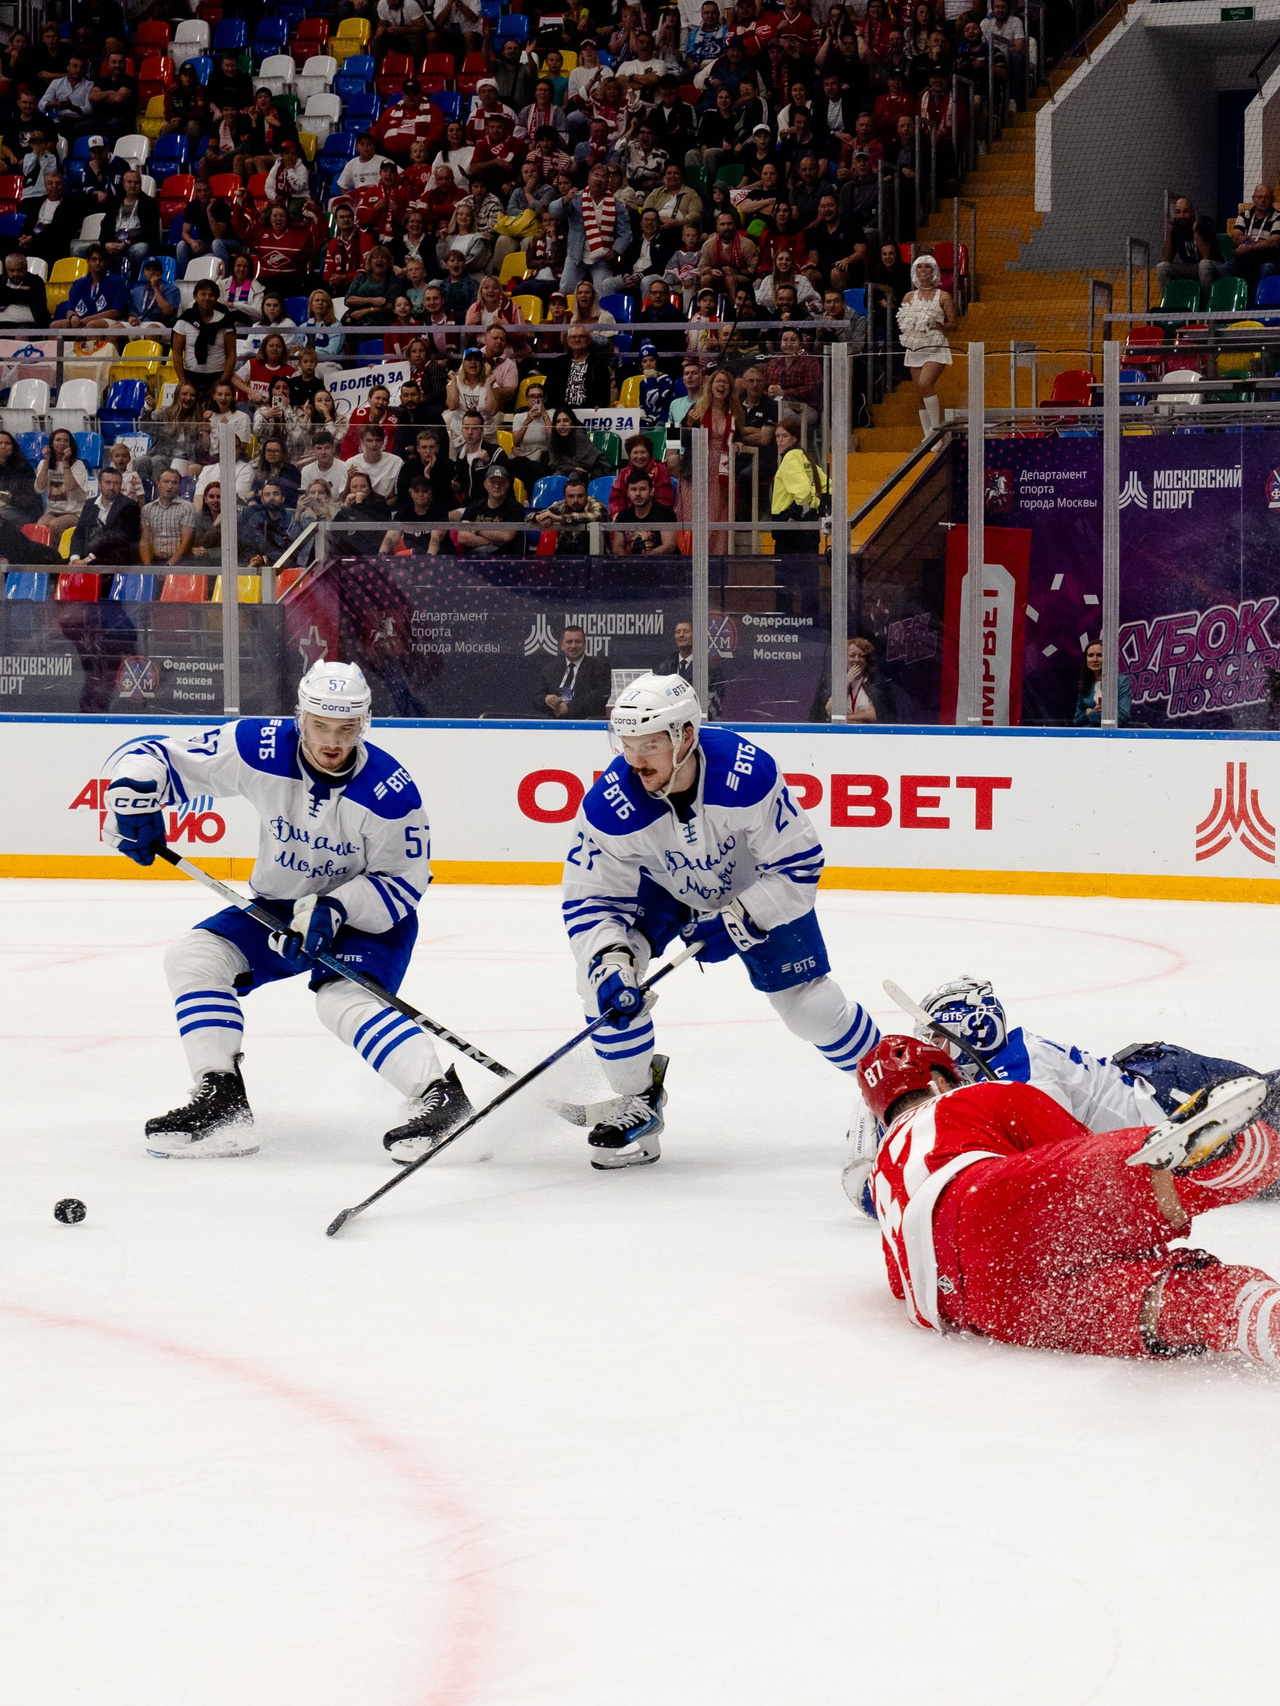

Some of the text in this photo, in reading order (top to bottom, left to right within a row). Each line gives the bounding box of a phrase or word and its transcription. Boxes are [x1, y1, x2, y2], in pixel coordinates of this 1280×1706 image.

[329, 371, 404, 393] Я БОЛЕЮ ЗА
[583, 416, 634, 431] ЛЕЮ ЗА
[1020, 470, 1088, 482] Департамент
[1153, 465, 1242, 489] МОСКОВСКИЙ
[1020, 485, 1055, 495] спорта
[1020, 498, 1098, 510] города Москвы
[1153, 490, 1195, 510] СПОРТ
[411, 610, 489, 623] Департамент
[741, 614, 814, 628] Федерация
[411, 627, 451, 638] спорта
[756, 633, 799, 643] хоккея
[1118, 598, 1278, 675] КУБОК
[411, 641, 501, 655] города Москвы
[584, 637, 611, 657] ОРТ
[708, 635, 731, 650] ХМ
[753, 647, 802, 661] Москвы
[0, 653, 73, 676] СКОВСКИЙ
[163, 658, 224, 672] Федерация
[0, 676, 25, 695] ОРТ
[176, 676, 213, 687] хоккея
[328, 679, 347, 692] 57
[173, 689, 216, 701] Москвы
[672, 684, 688, 698] ВТБ
[1169, 690, 1206, 715] ПО
[258, 726, 277, 761] ВТБ
[733, 742, 757, 776] ВТБ
[386, 767, 412, 794] ВТБ
[517, 768, 1014, 832] OPBET
[602, 783, 636, 821] ВТБ
[566, 831, 602, 871] 27
[274, 850, 349, 879] Моква
[343, 954, 363, 963] ВТБ
[794, 956, 817, 975] ВТБ
[942, 1012, 963, 1022] ВТБ
[415, 1014, 496, 1068] CCM
[864, 1060, 884, 1088] 87
